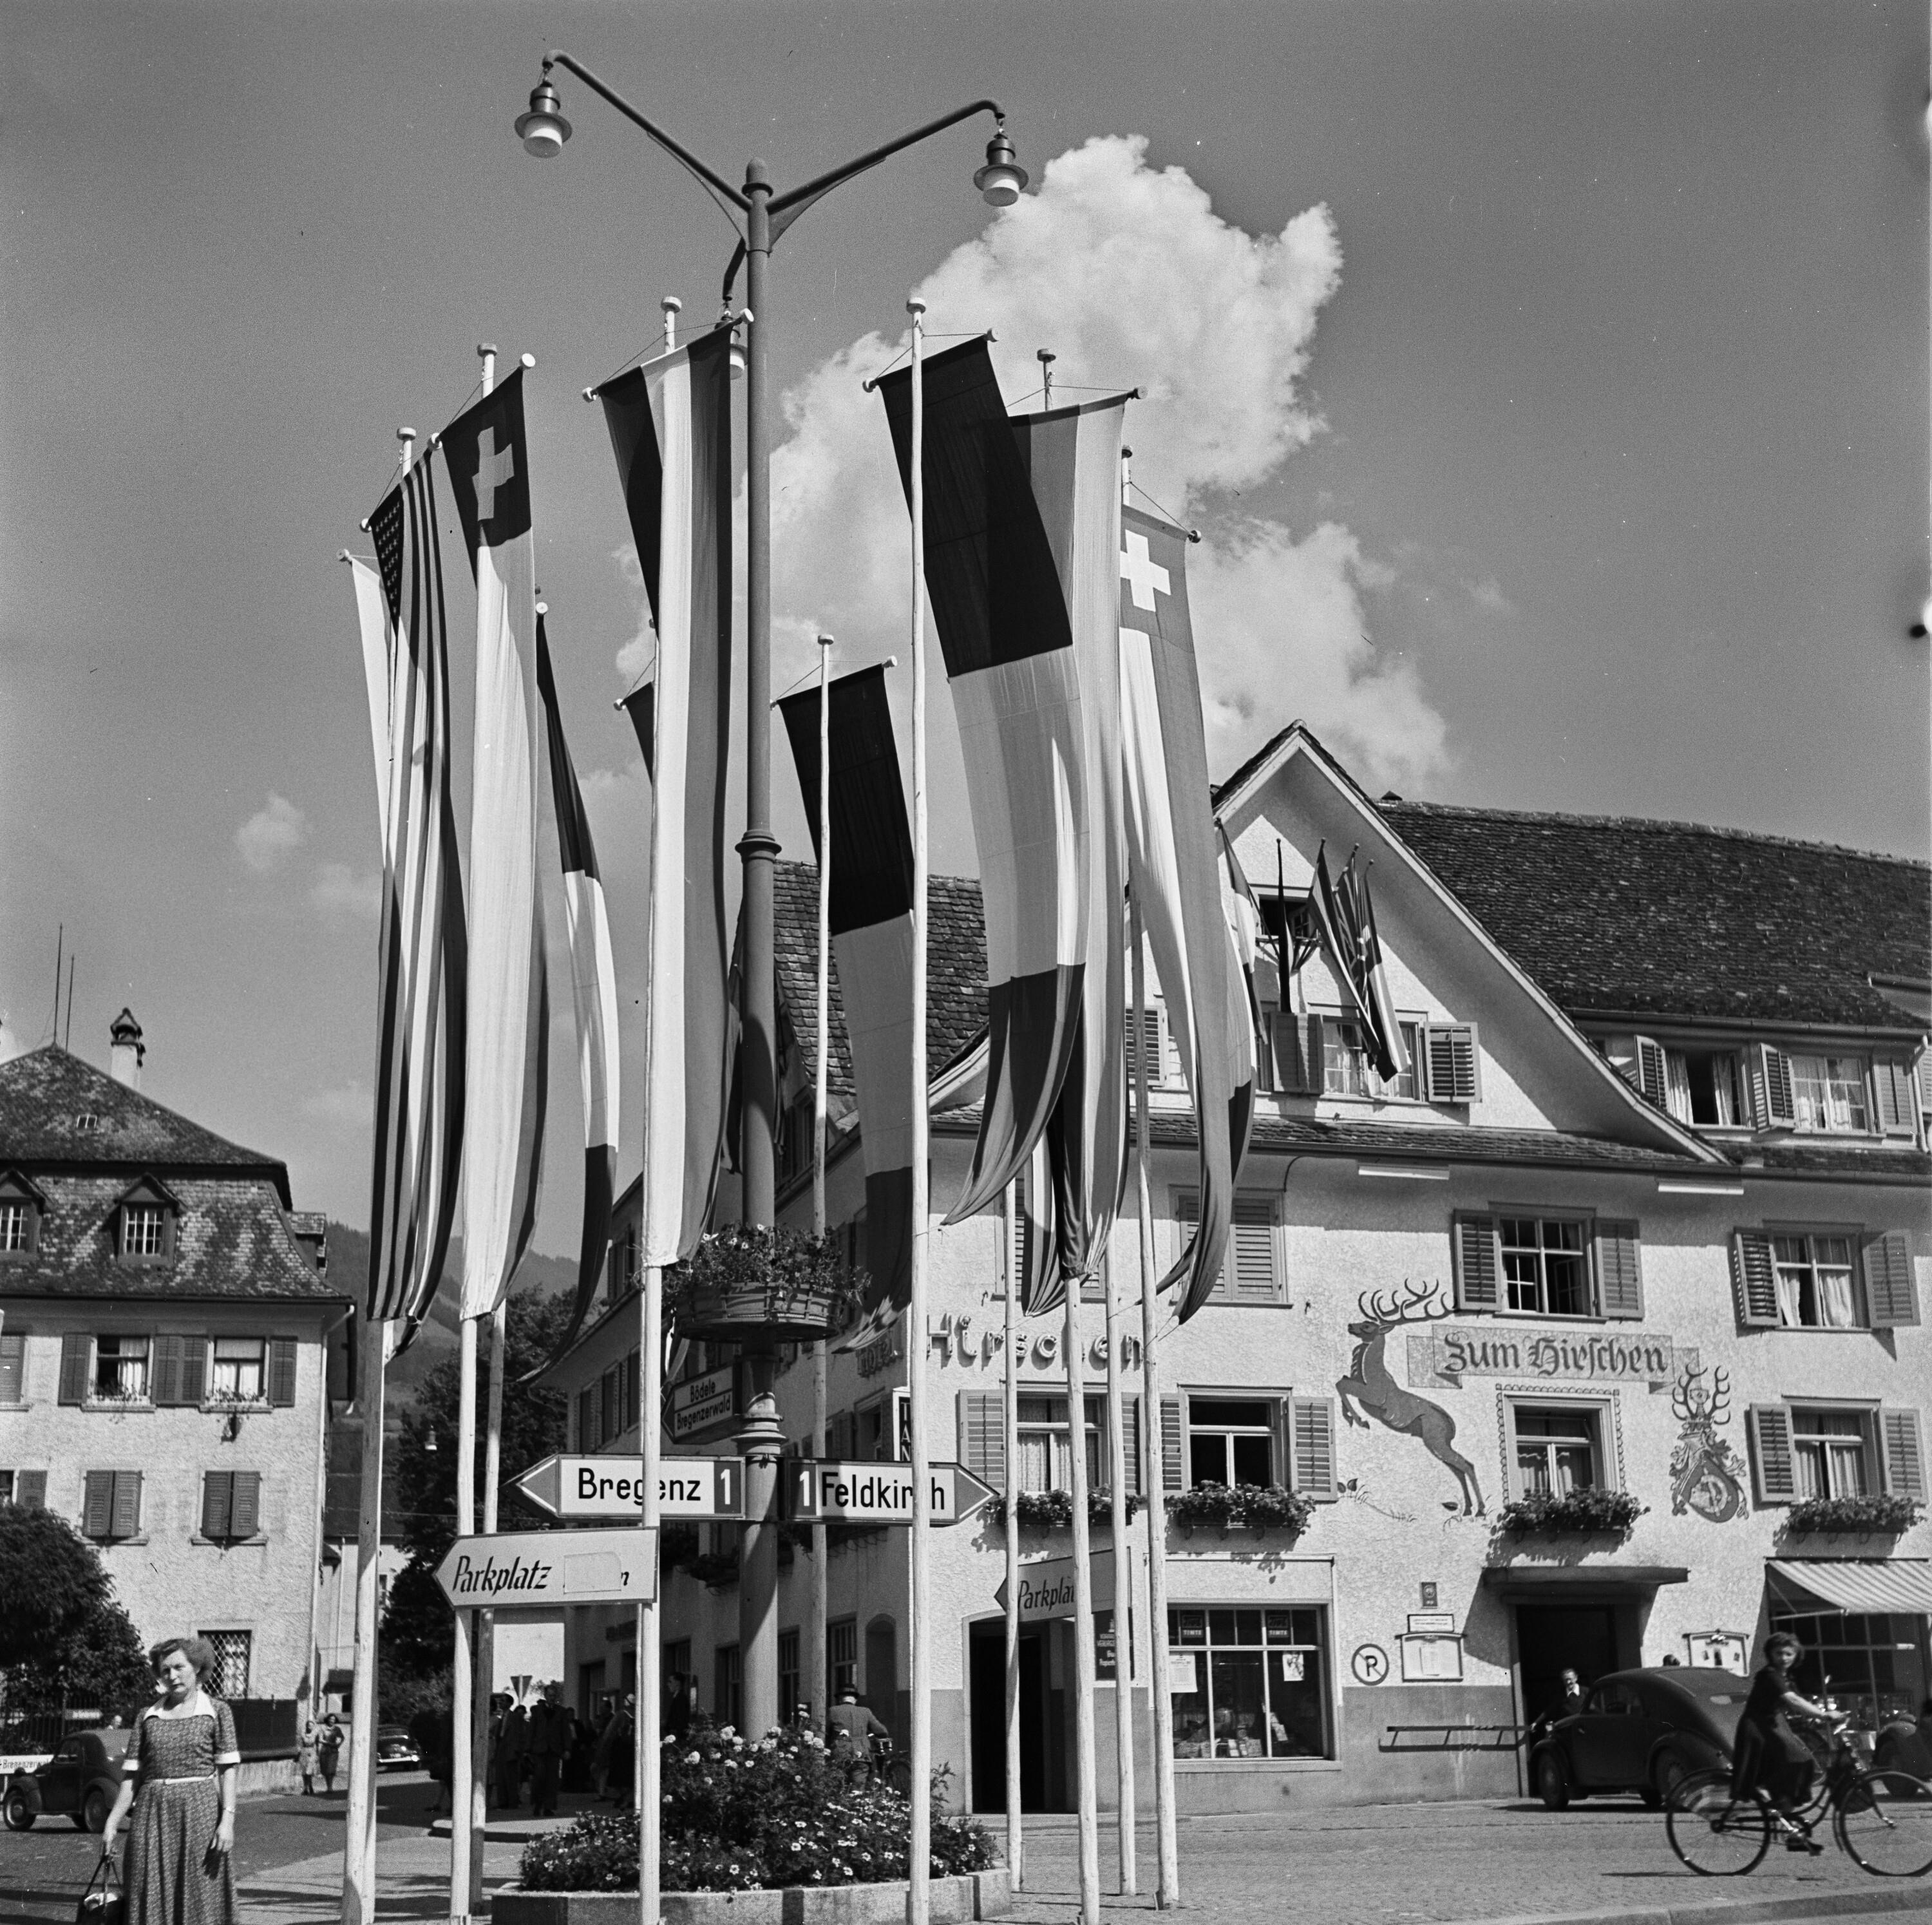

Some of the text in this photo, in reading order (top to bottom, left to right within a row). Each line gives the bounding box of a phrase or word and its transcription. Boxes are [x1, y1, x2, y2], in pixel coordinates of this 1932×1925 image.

[926, 1313, 1145, 1359] Hirscen
[1444, 1331, 1520, 1372] Zum
[690, 1378, 715, 1403] Bödele
[677, 1394, 731, 1430] Bregenzerwald
[720, 1468, 731, 1505] 1
[799, 1470, 945, 1510] 1 Feldkirh
[452, 1555, 553, 1597] Parkplatz
[1365, 1655, 1378, 1677] P
